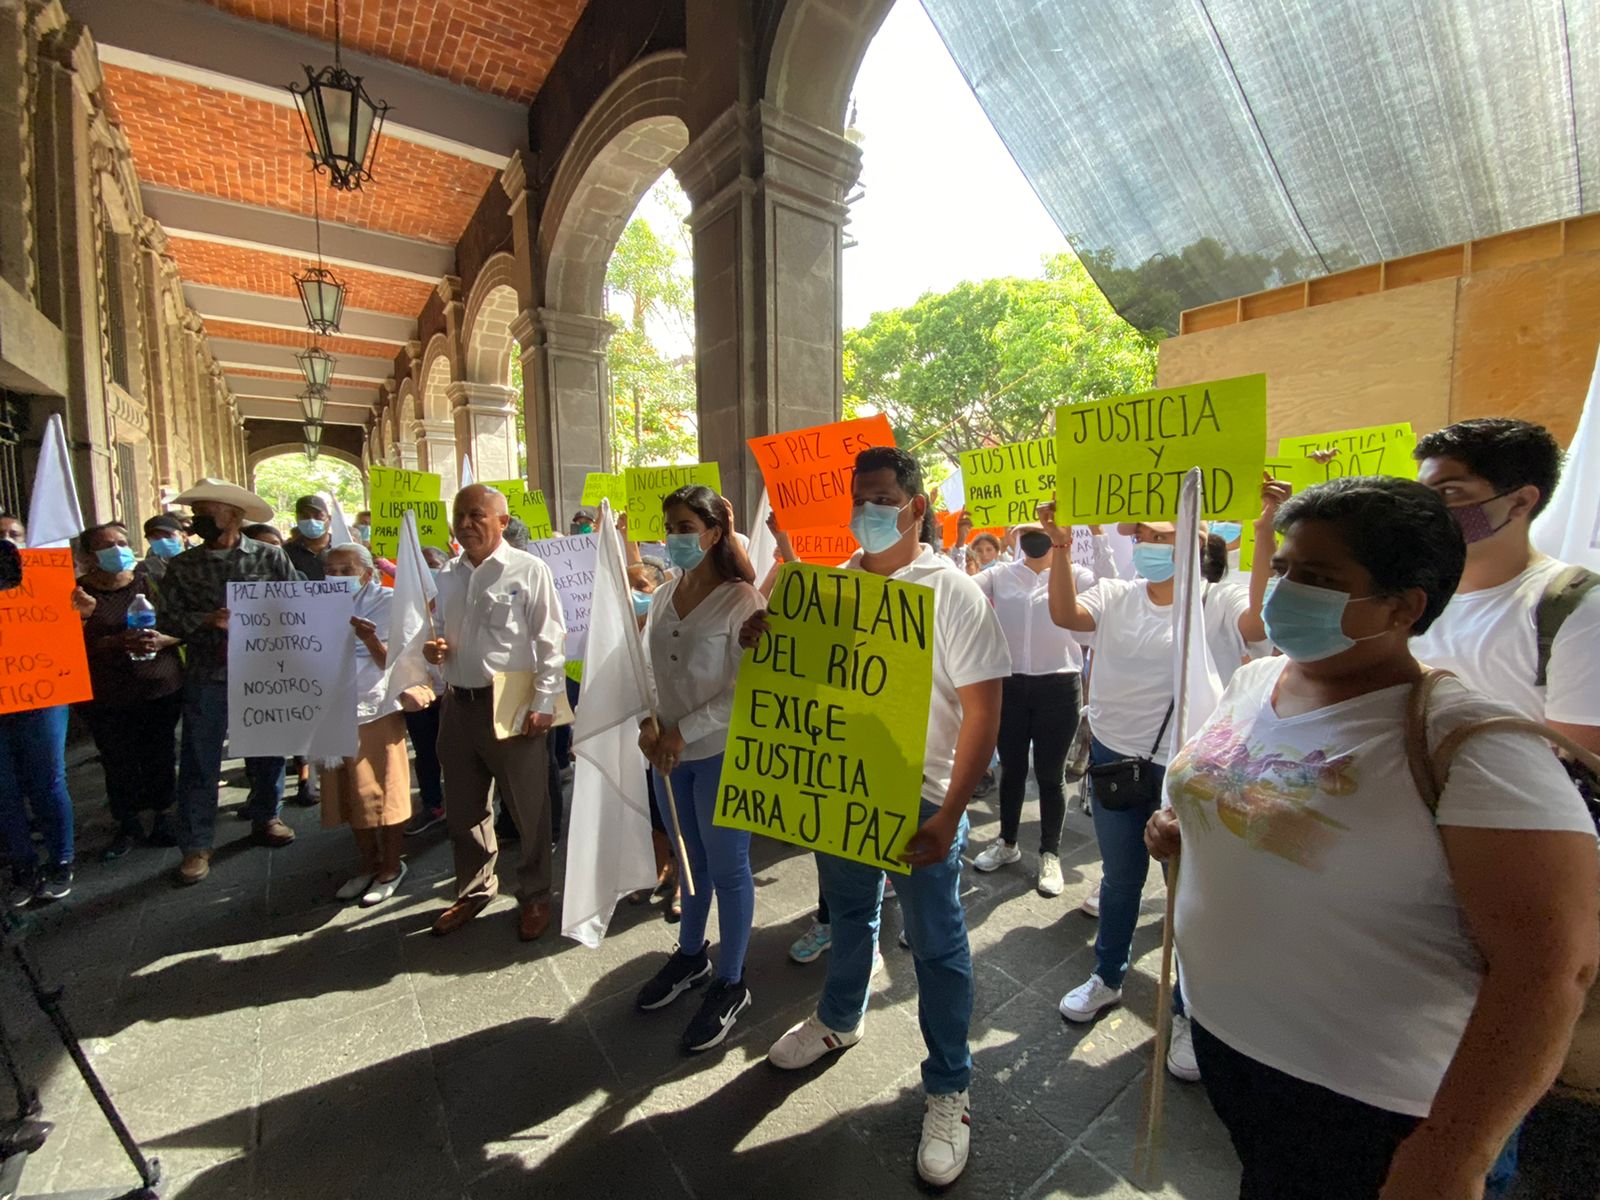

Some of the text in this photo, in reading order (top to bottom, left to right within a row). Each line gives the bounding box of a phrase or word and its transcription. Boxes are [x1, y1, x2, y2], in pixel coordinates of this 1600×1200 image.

[1071, 389, 1221, 445] JUSTICIA
[842, 433, 872, 455] ES
[968, 439, 1057, 476] JUSTICIA
[1147, 444, 1165, 469] Y
[371, 468, 424, 493] J PAZ
[632, 466, 699, 492] INOCENTE
[776, 465, 857, 510] INOCENT
[970, 484, 1003, 501] PARA
[1014, 479, 1030, 495] EL
[628, 497, 646, 513] ES
[1008, 498, 1040, 523] PAZ
[374, 526, 398, 537] PARA
[629, 518, 641, 530] LO
[531, 536, 598, 559] JUSTICIA
[791, 535, 857, 554] IBERTAD
[1077, 539, 1092, 553] AR
[22, 553, 70, 568] ZALEZ
[564, 558, 573, 571] Y
[553, 570, 596, 590] BERTA
[232, 581, 350, 602] PAZ ARCE GONZALEZ
[0, 605, 59, 623] TROS
[279, 611, 306, 626] CON
[245, 634, 323, 653] NOSOTROS
[276, 660, 285, 673] Y
[752, 629, 888, 697] DEL RÍO
[243, 677, 323, 697] NOSOTROS
[750, 689, 847, 746] EXIGE
[735, 736, 870, 798] JUSTICIA
